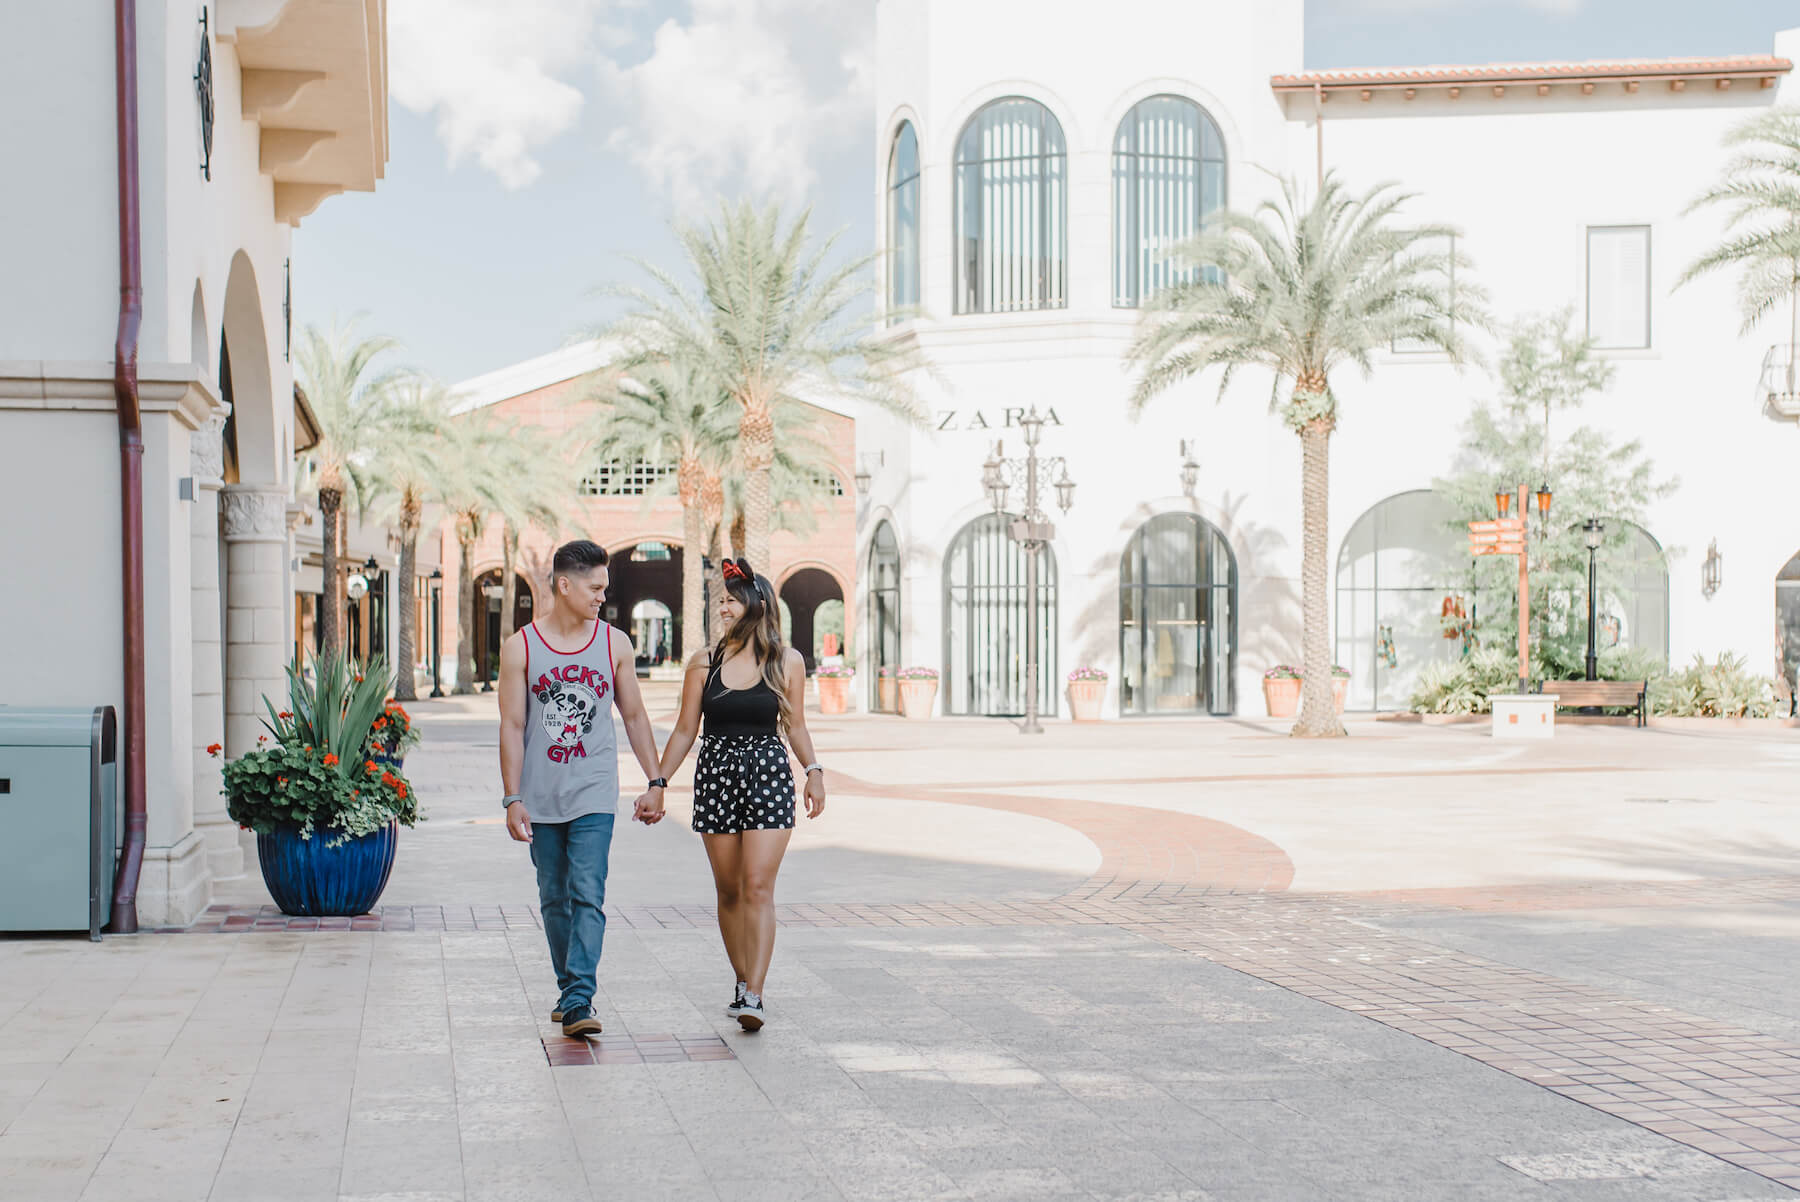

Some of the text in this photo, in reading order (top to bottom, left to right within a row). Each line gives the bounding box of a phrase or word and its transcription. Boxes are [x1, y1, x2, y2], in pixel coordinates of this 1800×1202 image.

[936, 407, 1064, 431] ZARA
[531, 665, 609, 699] MICK'S
[547, 741, 587, 764] GYM
